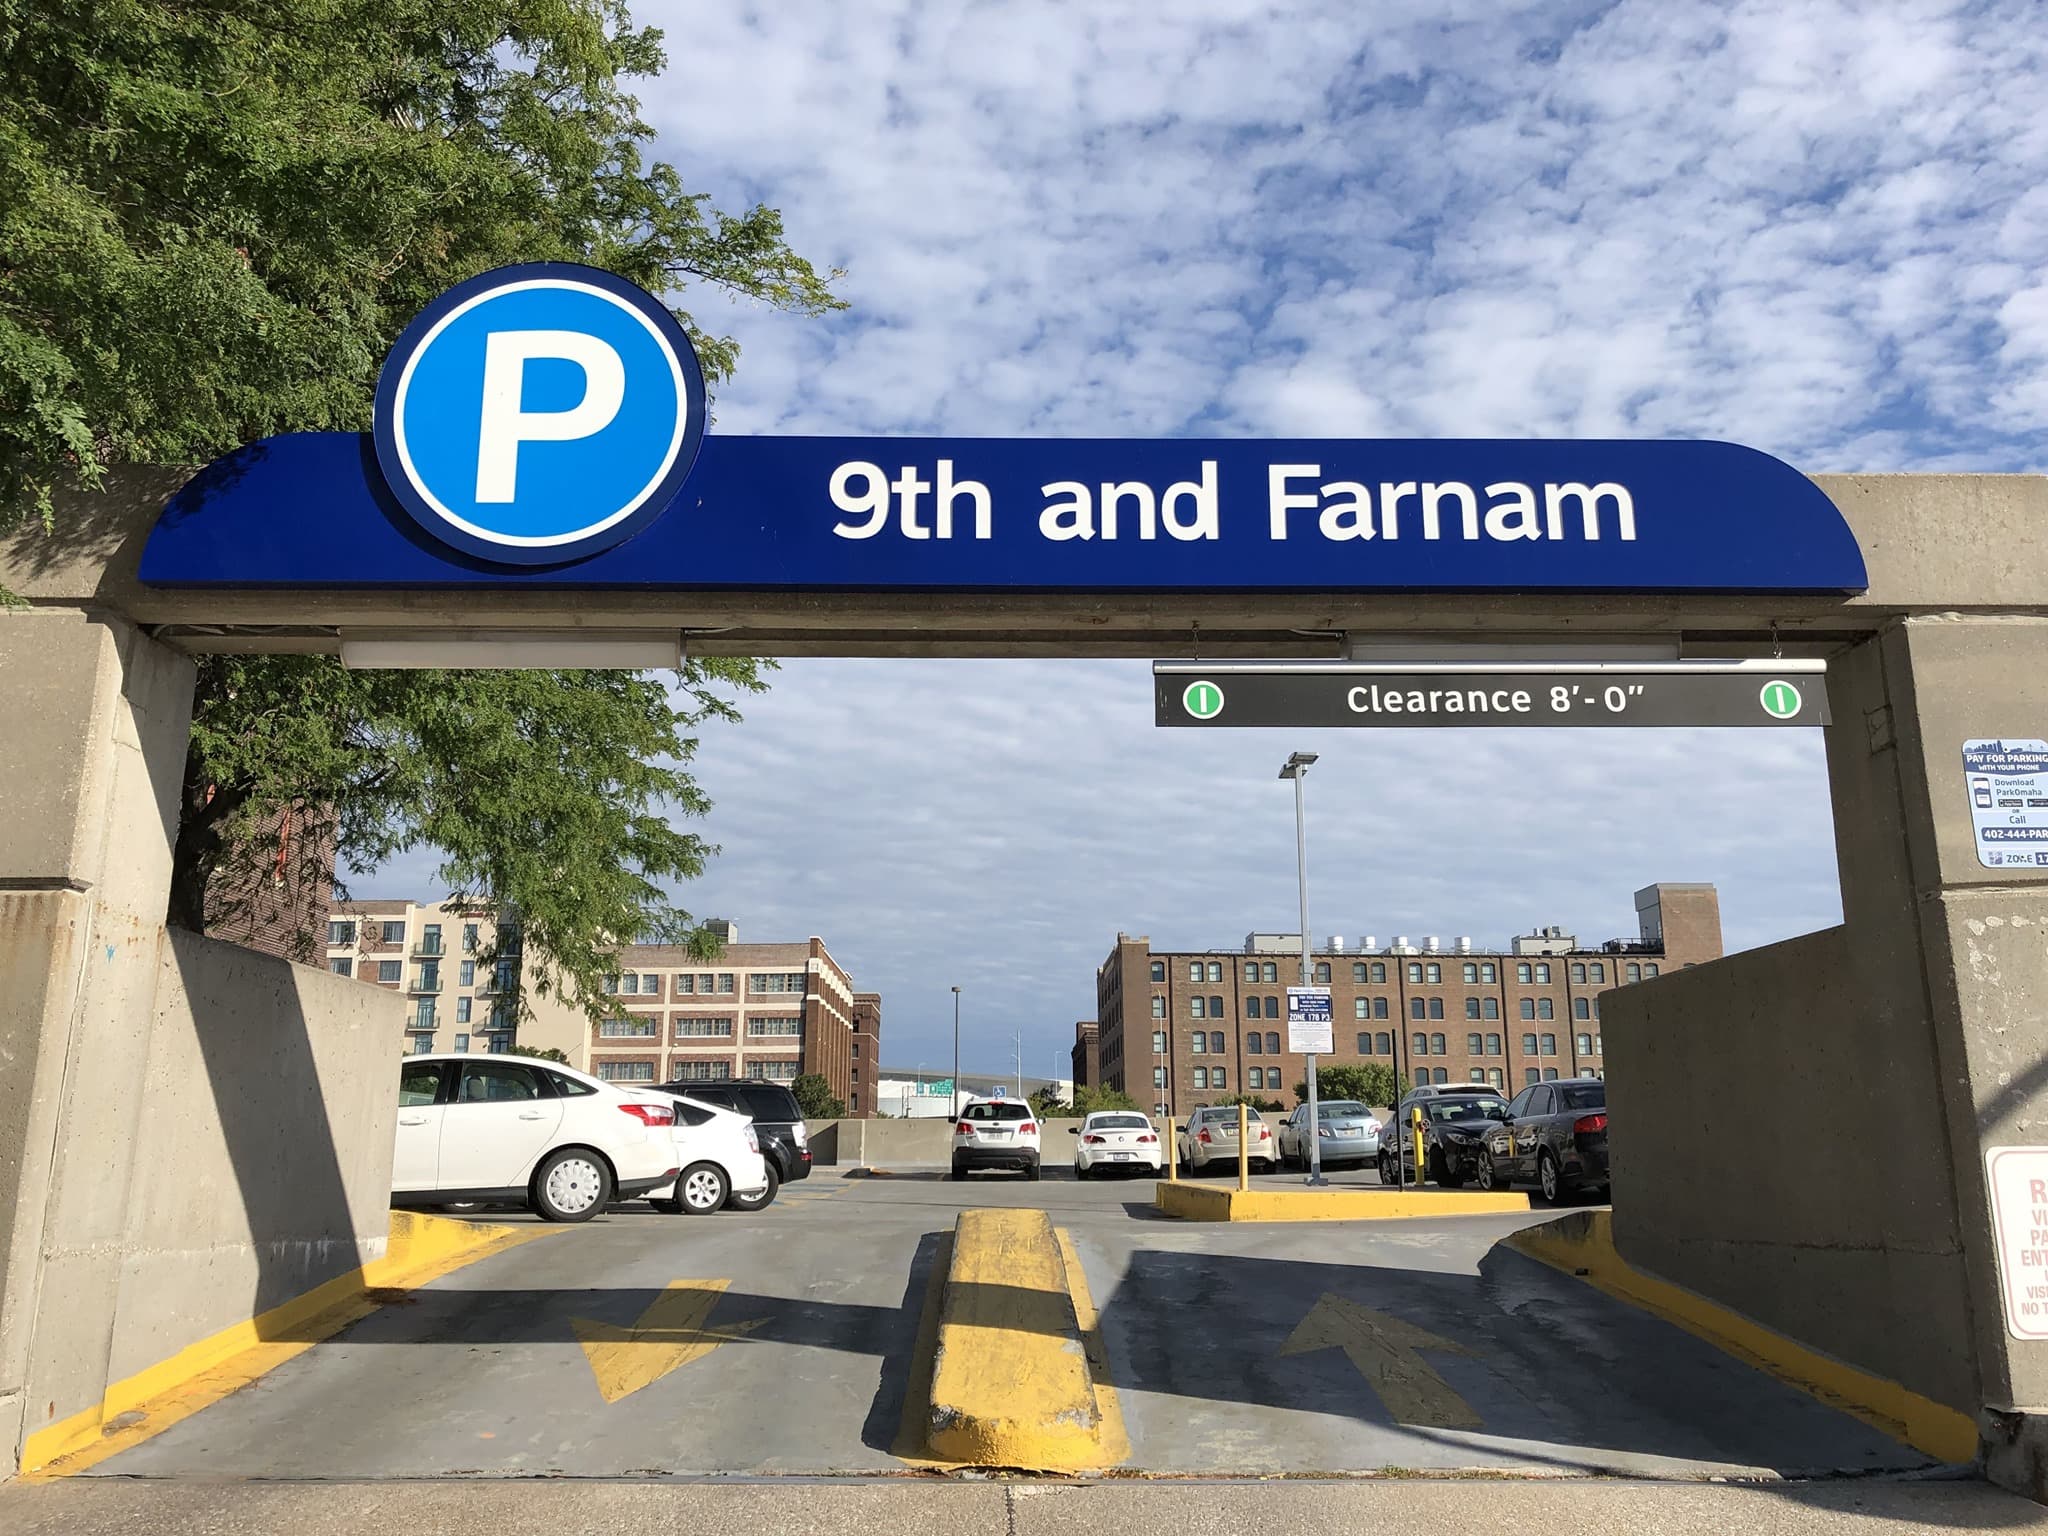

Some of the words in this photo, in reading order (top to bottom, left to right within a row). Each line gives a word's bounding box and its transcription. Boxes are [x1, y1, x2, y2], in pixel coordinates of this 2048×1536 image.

[475, 330, 626, 503] P
[829, 459, 991, 539] 9th
[1039, 460, 1219, 541] and
[1268, 463, 1636, 541] Farnam
[1347, 684, 1531, 713] Clearance
[1966, 754, 1984, 763] PAY
[1986, 754, 2005, 763] FOR
[1996, 788, 2043, 796] ParkOmaha
[2009, 815, 2026, 824] Call
[1289, 1013, 1306, 1021] ZONE
[2021, 1302, 2040, 1316] NO
